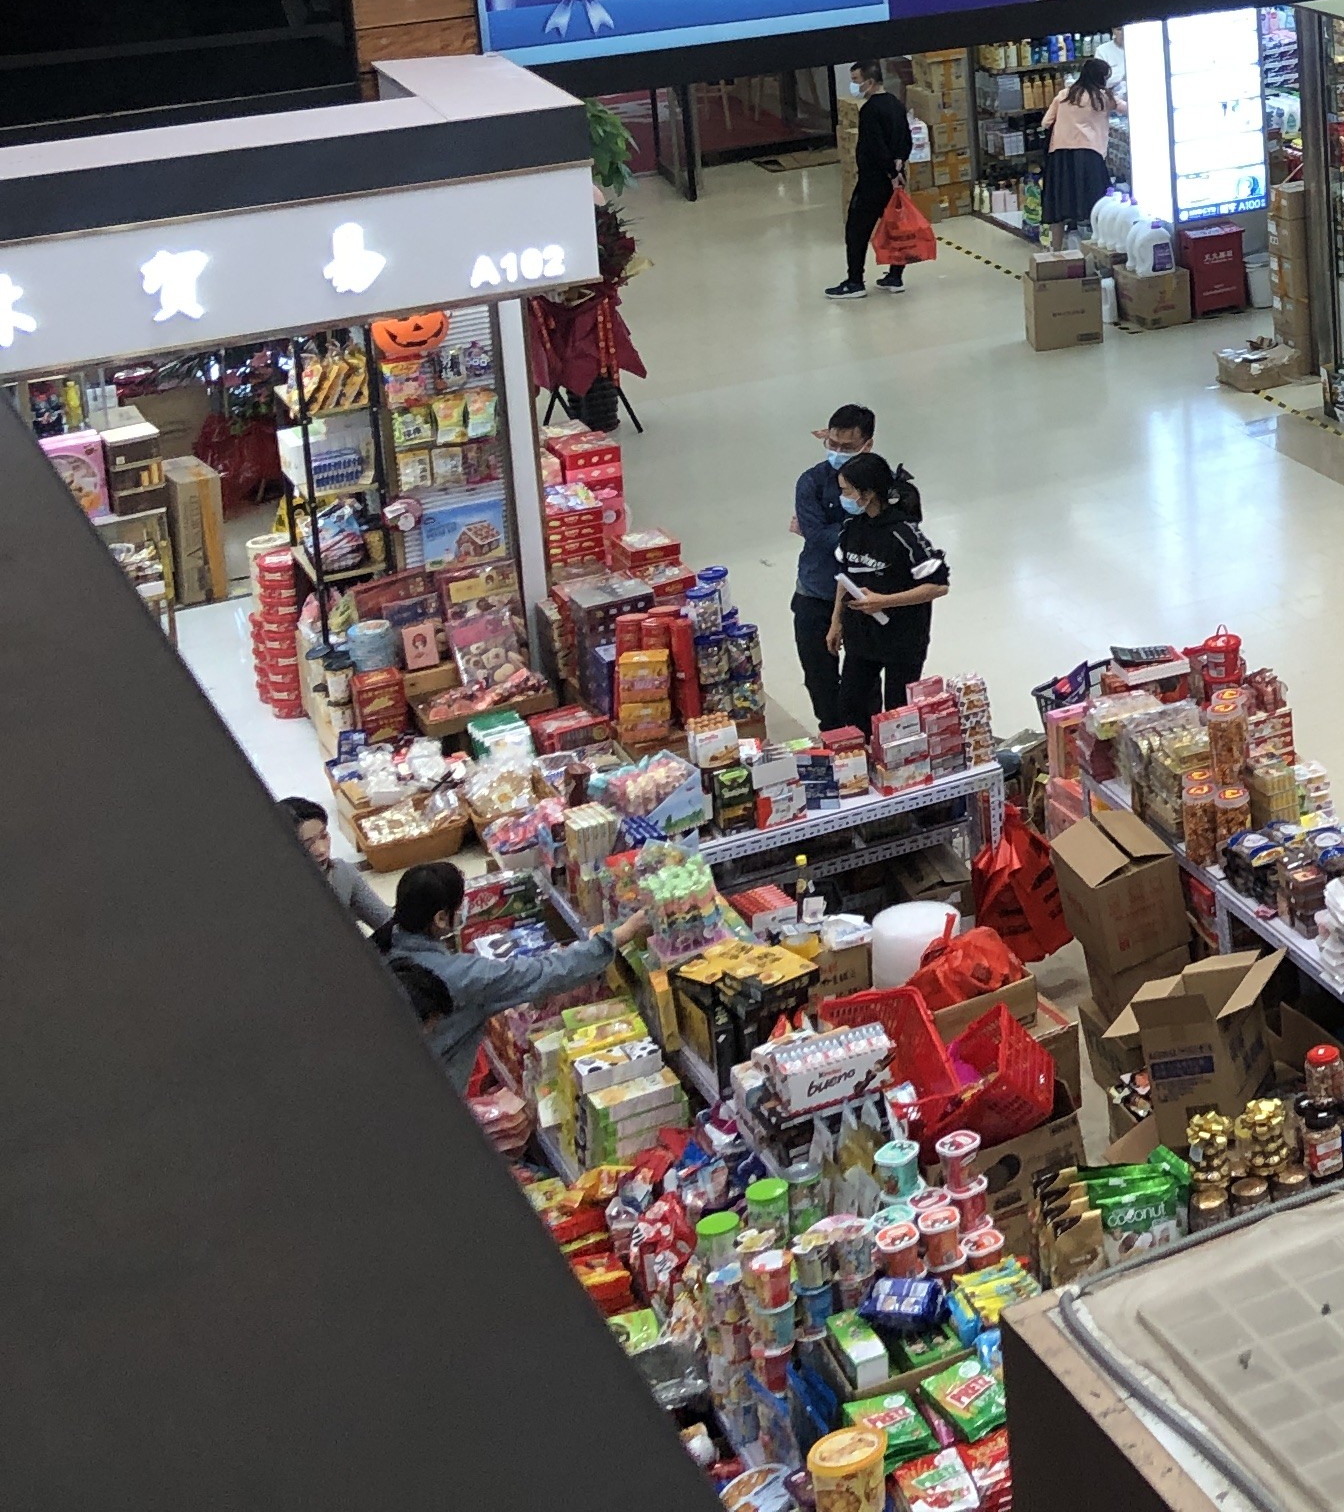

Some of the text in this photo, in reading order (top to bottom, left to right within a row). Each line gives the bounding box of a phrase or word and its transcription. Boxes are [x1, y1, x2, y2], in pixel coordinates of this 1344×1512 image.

[470, 244, 567, 288] A102
[806, 1069, 856, 1098] bueno
[1107, 1201, 1168, 1229] coconut
